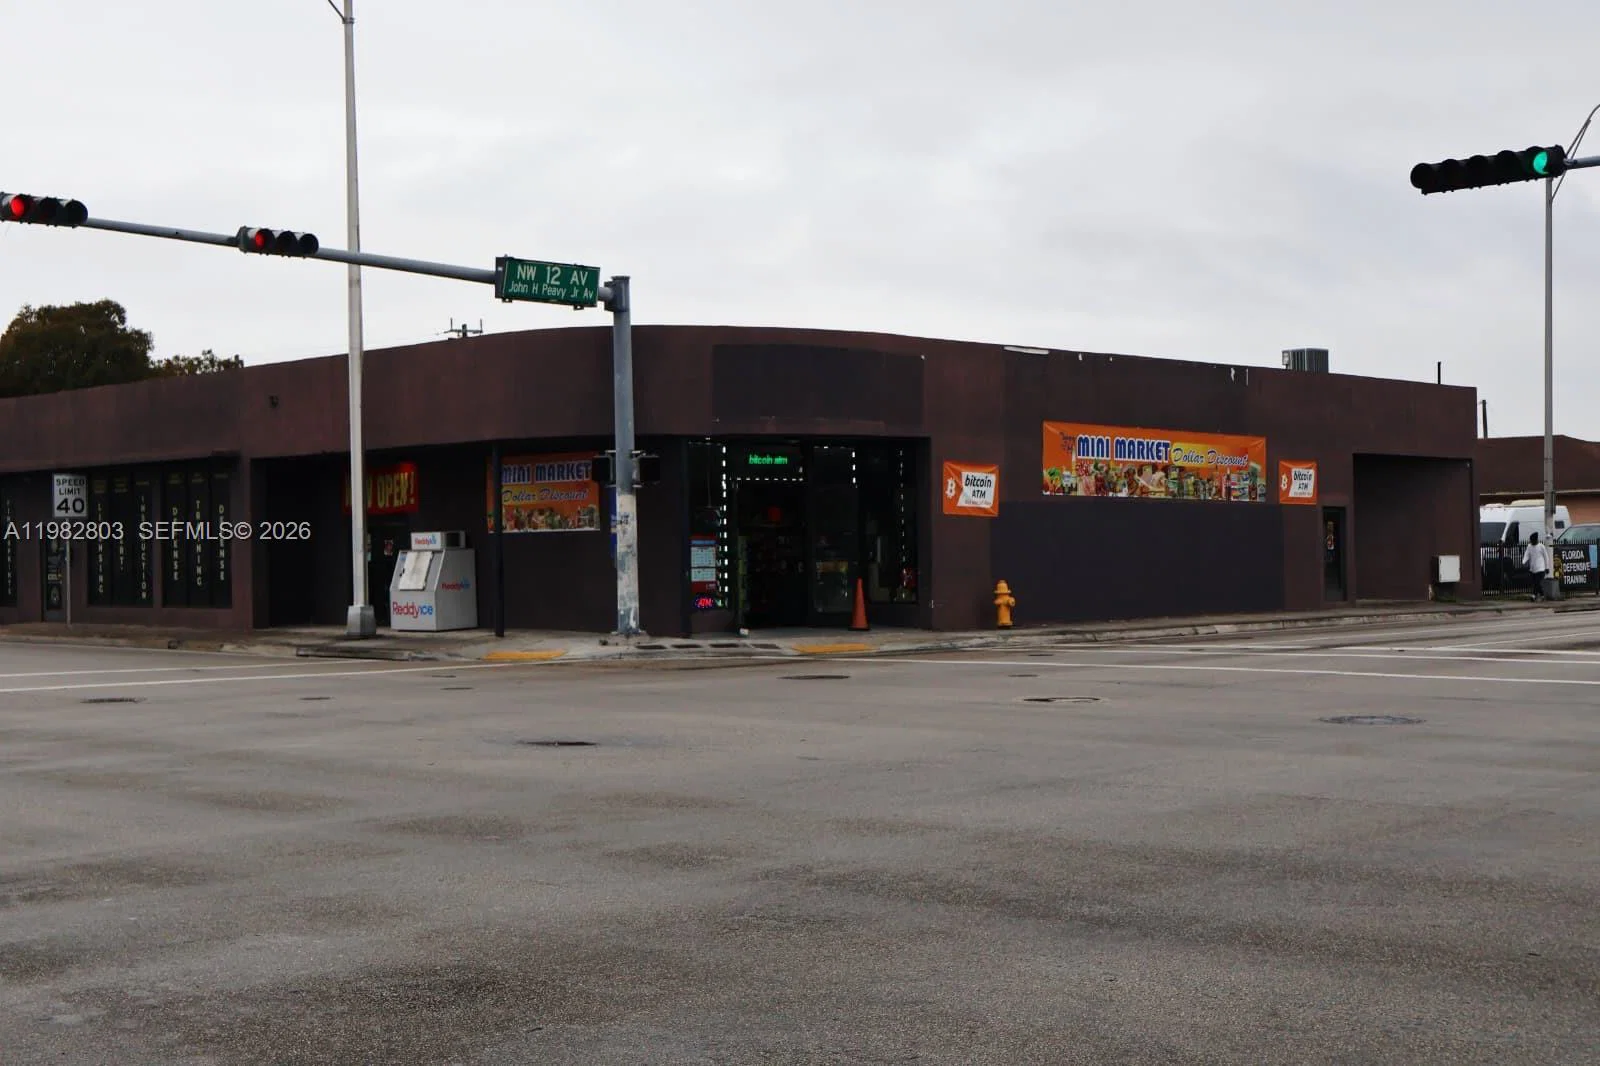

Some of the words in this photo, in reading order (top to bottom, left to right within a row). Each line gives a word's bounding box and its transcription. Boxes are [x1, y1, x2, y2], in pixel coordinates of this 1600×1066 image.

[517, 264, 537, 281] NW
[546, 266, 561, 285] 12
[570, 270, 588, 286] AV
[508, 281, 529, 293] John
[532, 283, 539, 294] H
[542, 284, 566, 299] Peavy
[570, 287, 579, 298] Jr
[583, 287, 594, 299] Av
[1077, 435, 1110, 459] MINI
[1114, 437, 1170, 462] MARKET
[1172, 447, 1204, 464] Dollar
[1207, 449, 1248, 467] Discount
[502, 464, 531, 483] MINI
[535, 461, 592, 483] MARKET
[56, 478, 85, 486] SPEED
[965, 474, 992, 488] bitcoin
[59, 488, 81, 496] LIMIT
[502, 489, 536, 502] Dollar
[540, 487, 588, 501] Discount
[972, 489, 986, 499] ATM
[56, 498, 85, 514] 40
[1562, 550, 1585, 560] FLORIDA
[1562, 561, 1591, 572] DEFENSIVE
[1563, 574, 1587, 585] TRAINING
